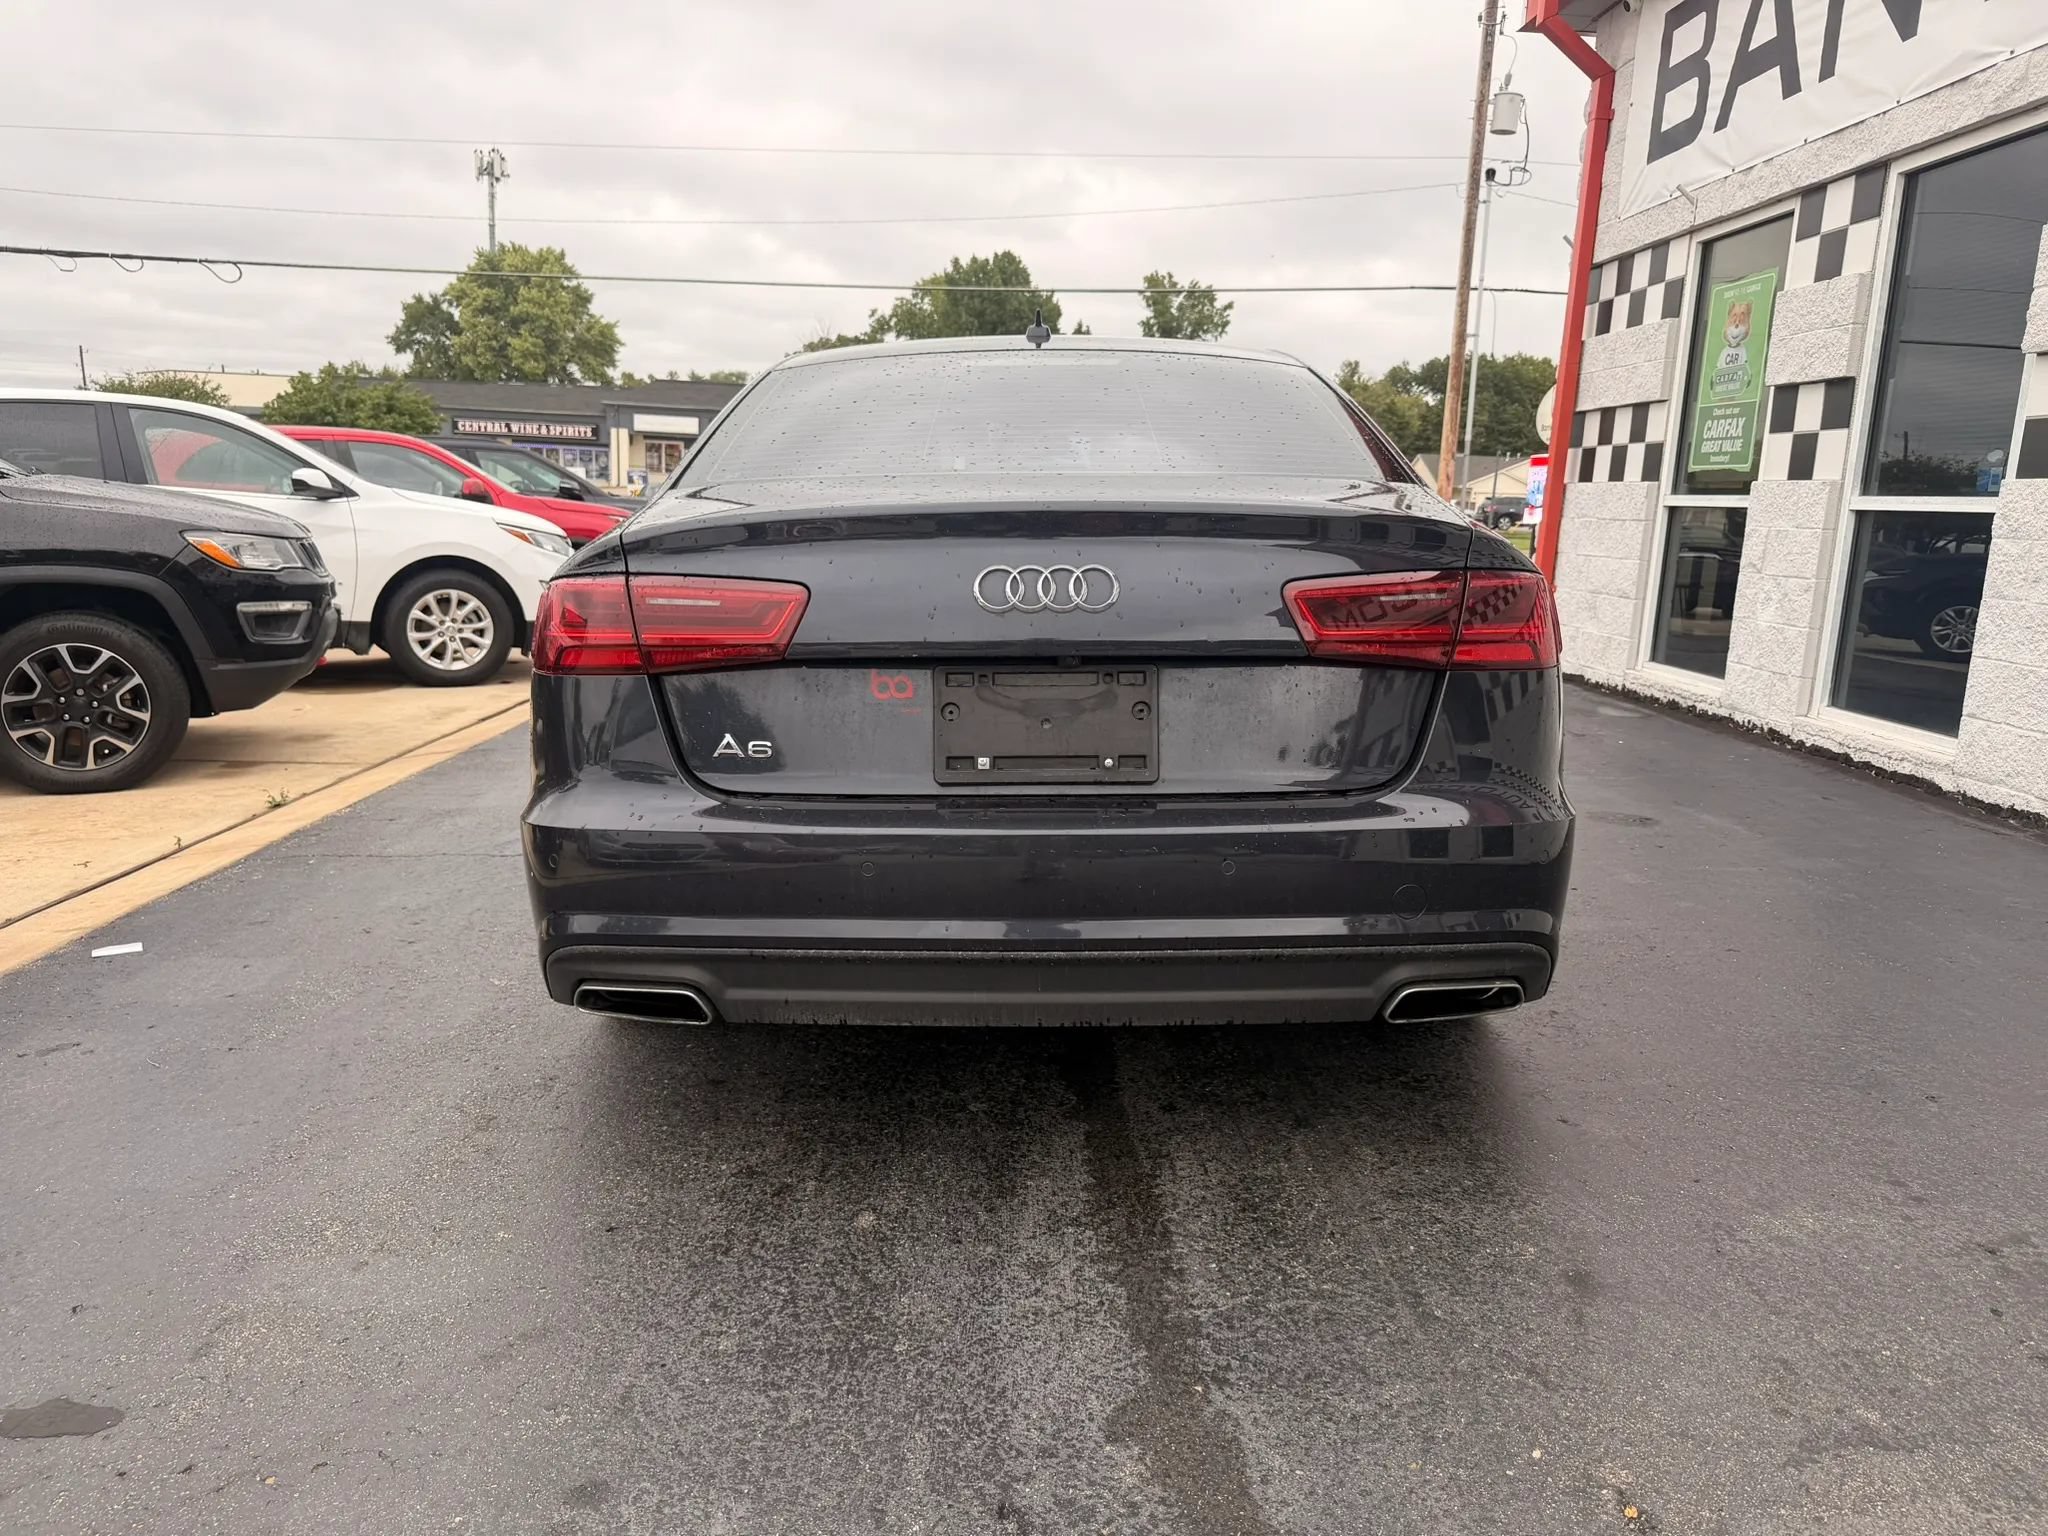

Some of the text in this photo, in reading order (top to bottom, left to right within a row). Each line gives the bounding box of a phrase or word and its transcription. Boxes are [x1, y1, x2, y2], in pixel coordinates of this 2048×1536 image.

[457, 421, 508, 433] CENTRAL
[1703, 417, 1746, 439] CARFAX
[1701, 439, 1743, 453] GREAT VALUE
[712, 732, 773, 758] A6
